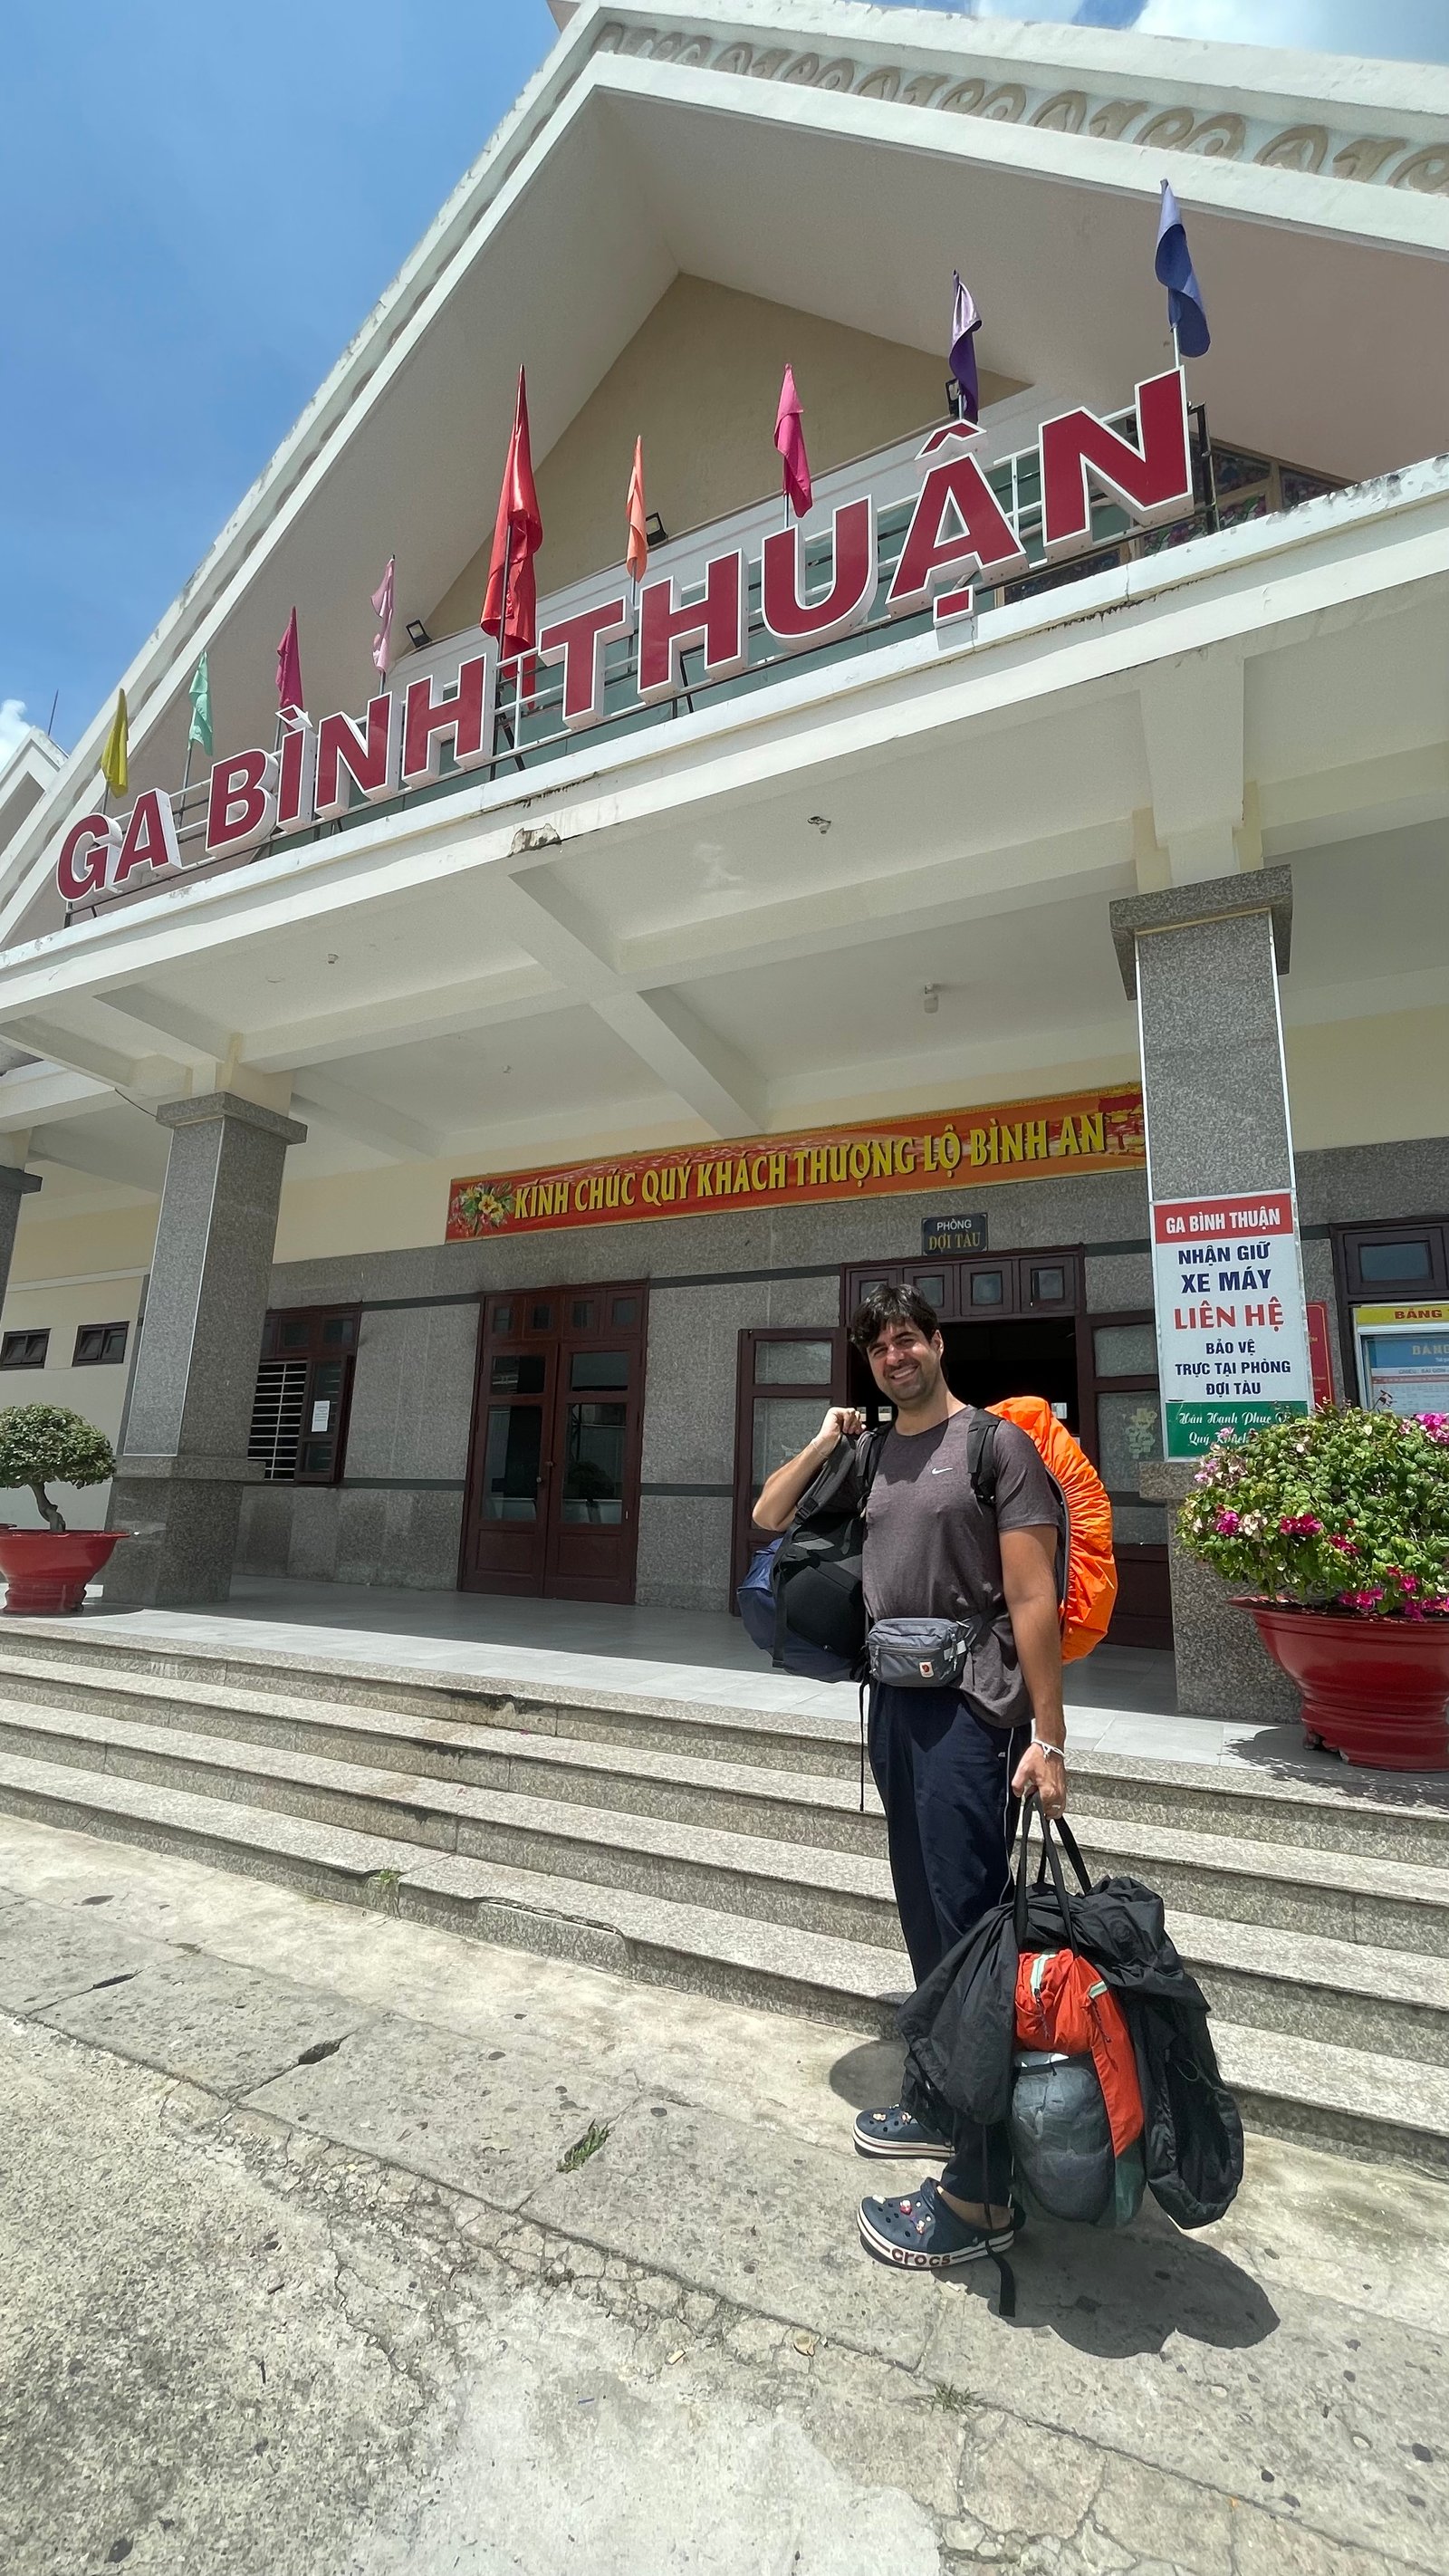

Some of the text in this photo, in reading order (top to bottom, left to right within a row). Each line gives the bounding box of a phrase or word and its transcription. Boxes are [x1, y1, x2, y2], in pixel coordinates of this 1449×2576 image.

[56, 365, 1194, 902] GA BÌNH THUẬN
[514, 1112, 1106, 1219] KÍNH CHÚC QUÝ KHÁCH THƯỢNG LỘ BÌNH AN
[936, 1218, 972, 1231] PHÒNG
[1166, 1206, 1281, 1235] GA BÌNH THUẬN
[955, 1229, 981, 1248] TÀU
[1178, 1241, 1271, 1266] NHẬN GIỮ
[1181, 1265, 1271, 1293] XE MÁY
[1174, 1296, 1284, 1332] LIÊN HỆ
[1205, 1338, 1255, 1356] BẢO VỆ
[1175, 1359, 1291, 1378] TRỰC TẠI PHÒNG
[1205, 1380, 1262, 1398] ĐỢI TÀU
[891, 2248, 952, 2265] crocs
